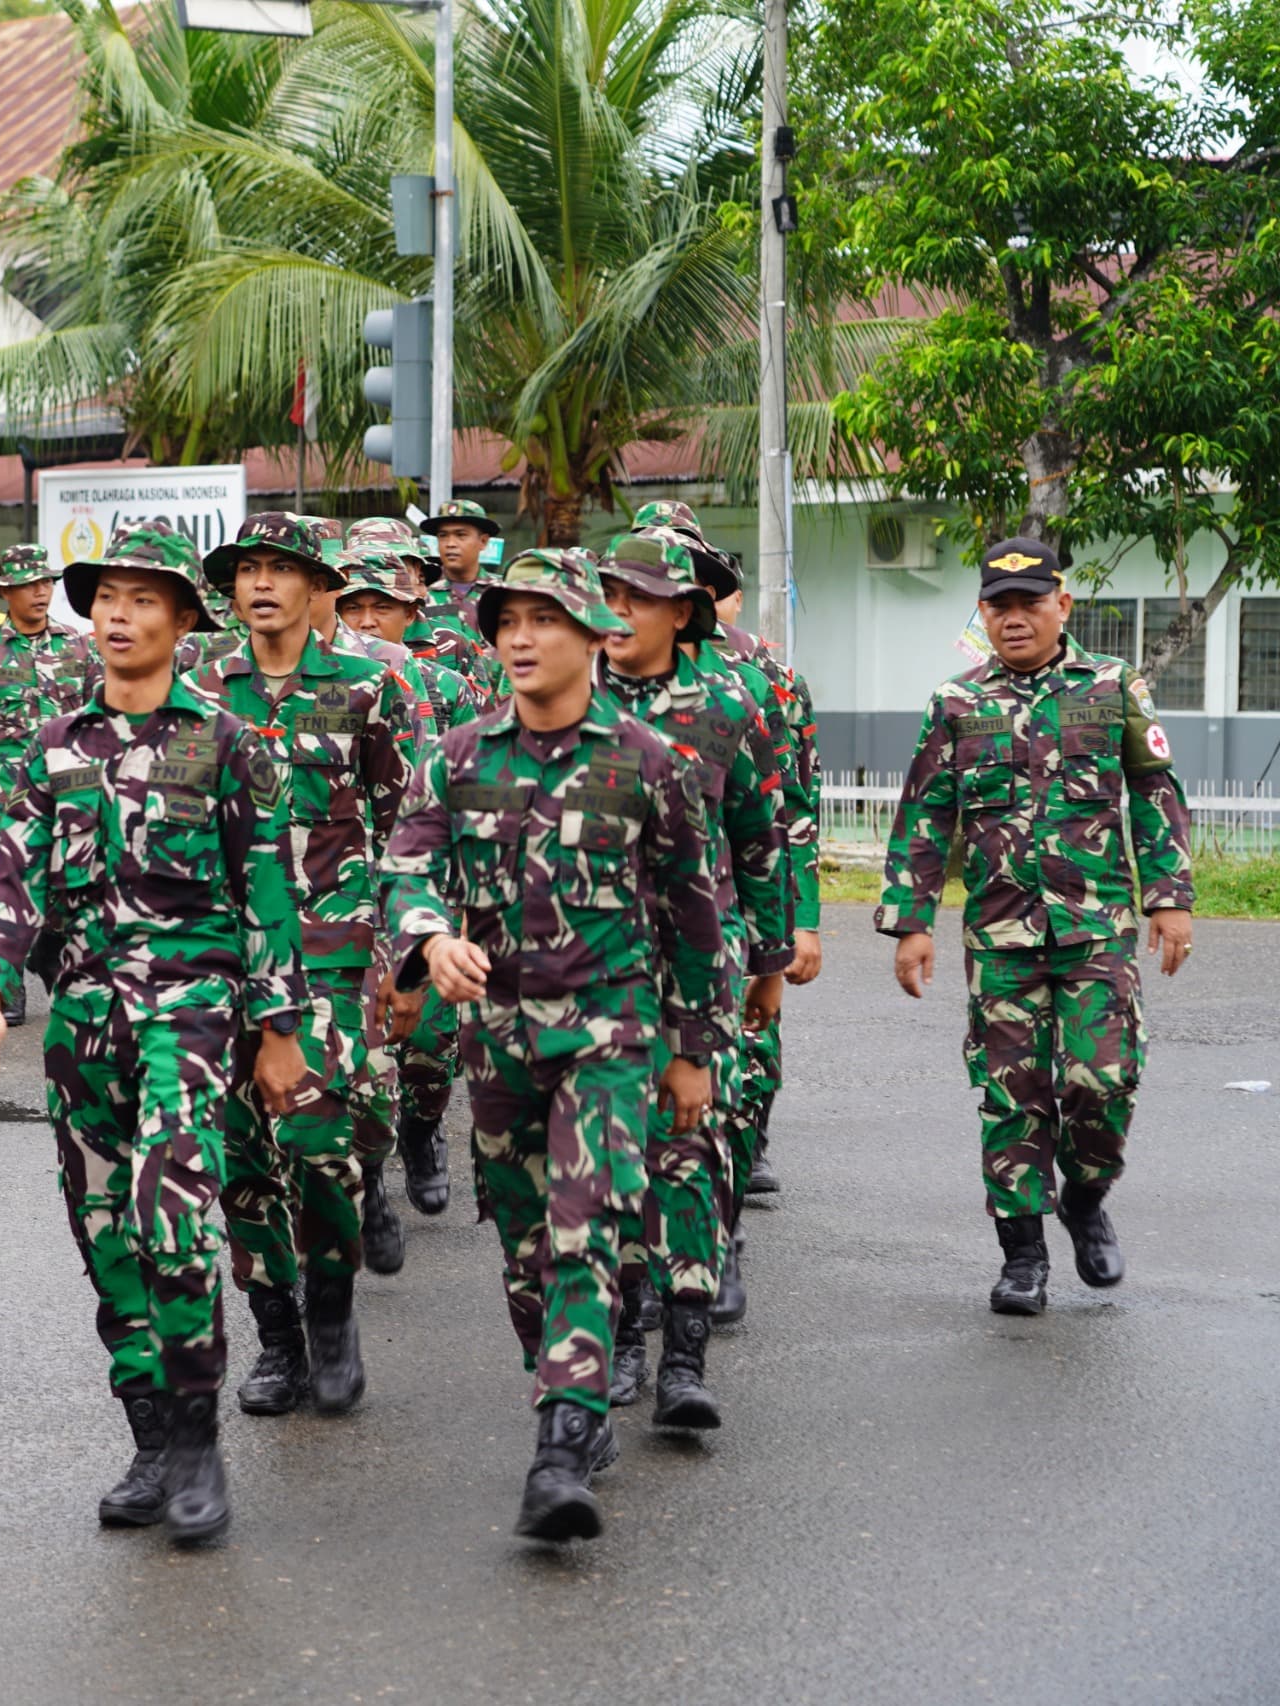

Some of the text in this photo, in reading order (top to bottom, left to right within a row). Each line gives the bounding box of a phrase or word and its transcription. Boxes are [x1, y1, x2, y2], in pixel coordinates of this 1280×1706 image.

[59, 485, 228, 503] KOMITE OLAHRAGA NASIONAL INDONESIA
[110, 507, 226, 551] (NI)
[301, 717, 328, 731] TNI
[1067, 711, 1092, 723] TNI
[150, 765, 189, 781] TNI
